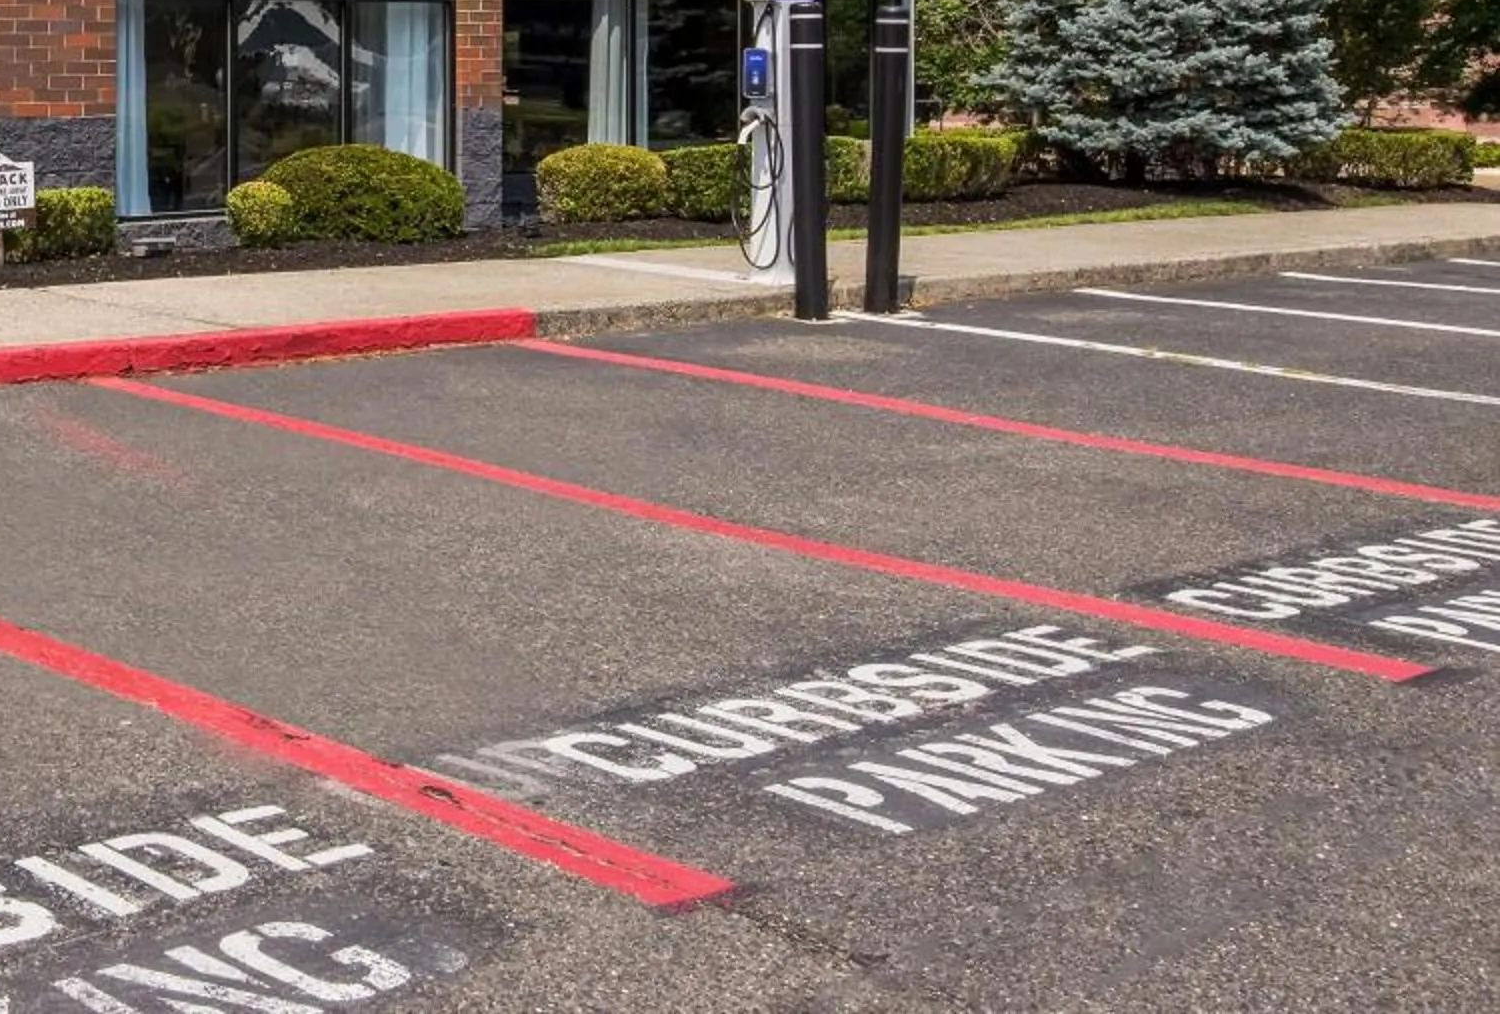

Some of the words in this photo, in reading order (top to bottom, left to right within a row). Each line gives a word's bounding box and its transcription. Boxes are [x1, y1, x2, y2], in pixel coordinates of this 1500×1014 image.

[3, 195, 28, 208] ONLY
[543, 625, 1164, 784] CURBSIDE
[764, 685, 1275, 834] PARKING
